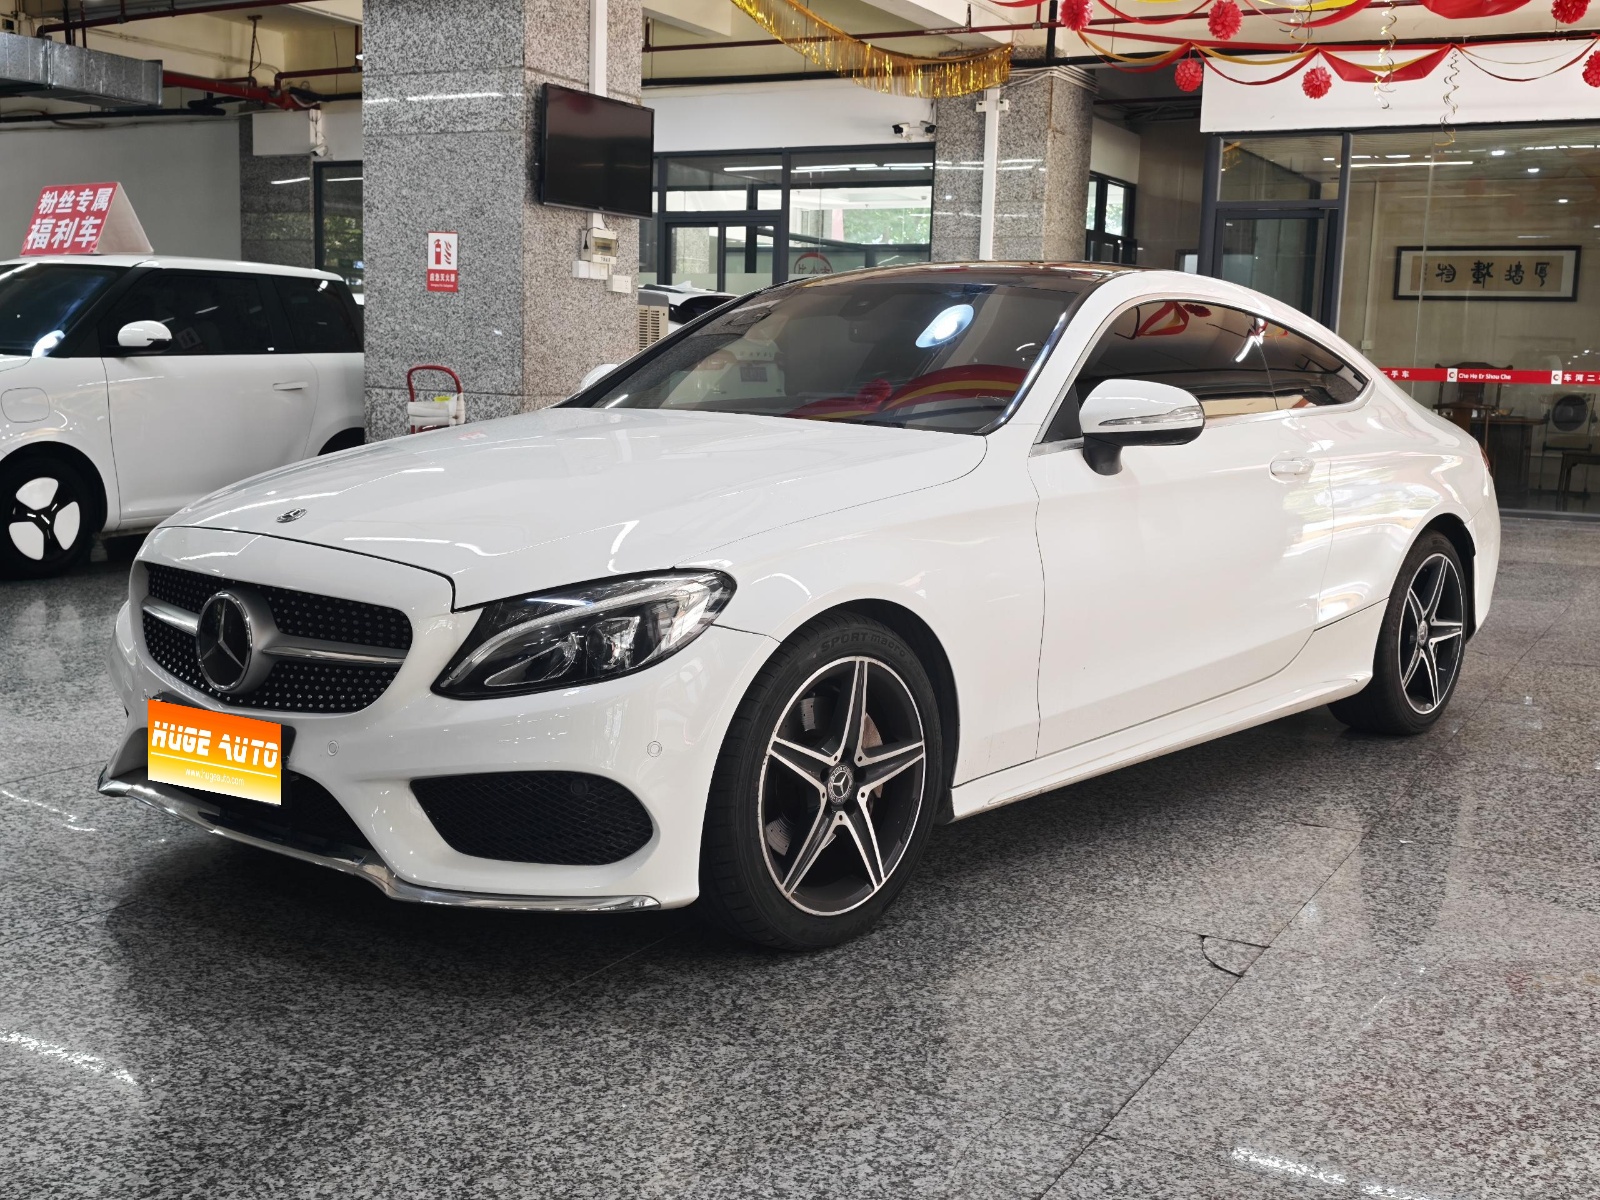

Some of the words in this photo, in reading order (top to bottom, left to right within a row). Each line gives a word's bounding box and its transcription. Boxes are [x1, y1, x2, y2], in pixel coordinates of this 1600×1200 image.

[38, 187, 113, 214] 粉丝专属
[26, 215, 102, 249] 福利车
[1563, 373, 1600, 382] 车河二
[820, 632, 868, 653] SPORT
